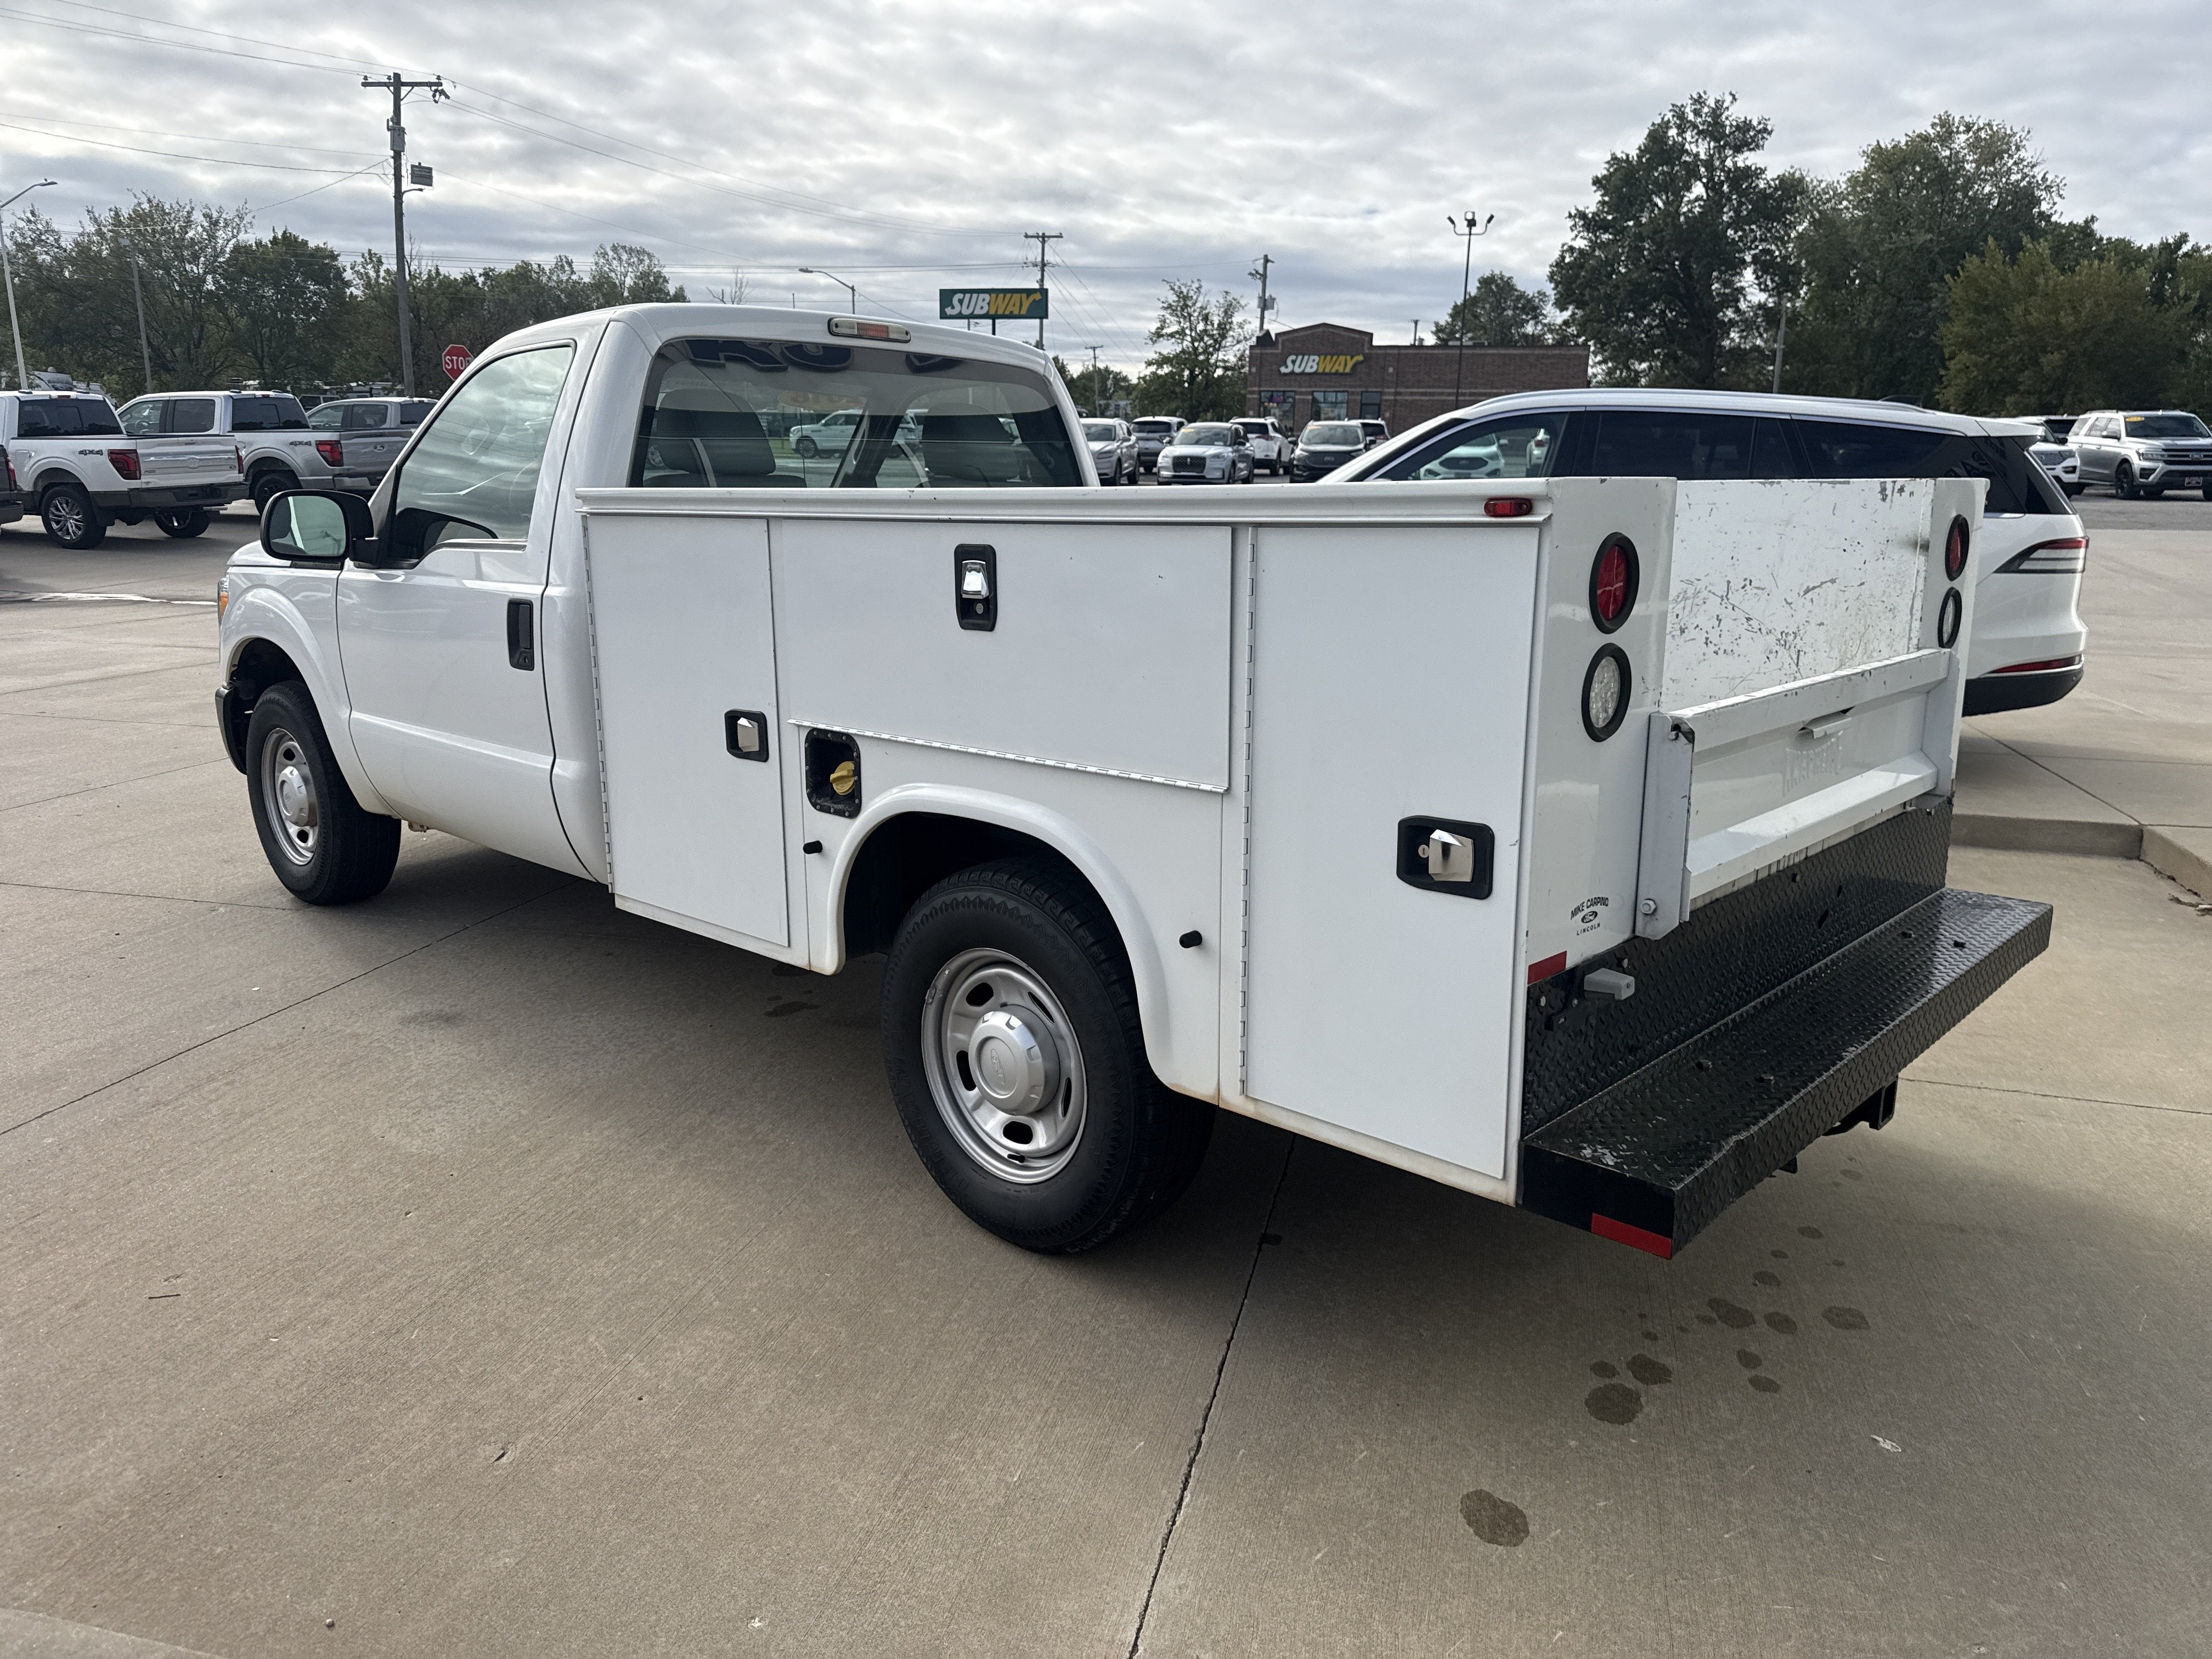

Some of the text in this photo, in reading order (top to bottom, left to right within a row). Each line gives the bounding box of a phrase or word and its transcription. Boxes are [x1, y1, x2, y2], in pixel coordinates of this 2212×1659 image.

[945, 292, 1041, 316] SUBWAY
[1279, 354, 1364, 374] SUBWAY
[1571, 901, 1585, 920] MIKE
[1587, 897, 1609, 909] CARPINO
[1577, 922, 1600, 935] LINCOLN
